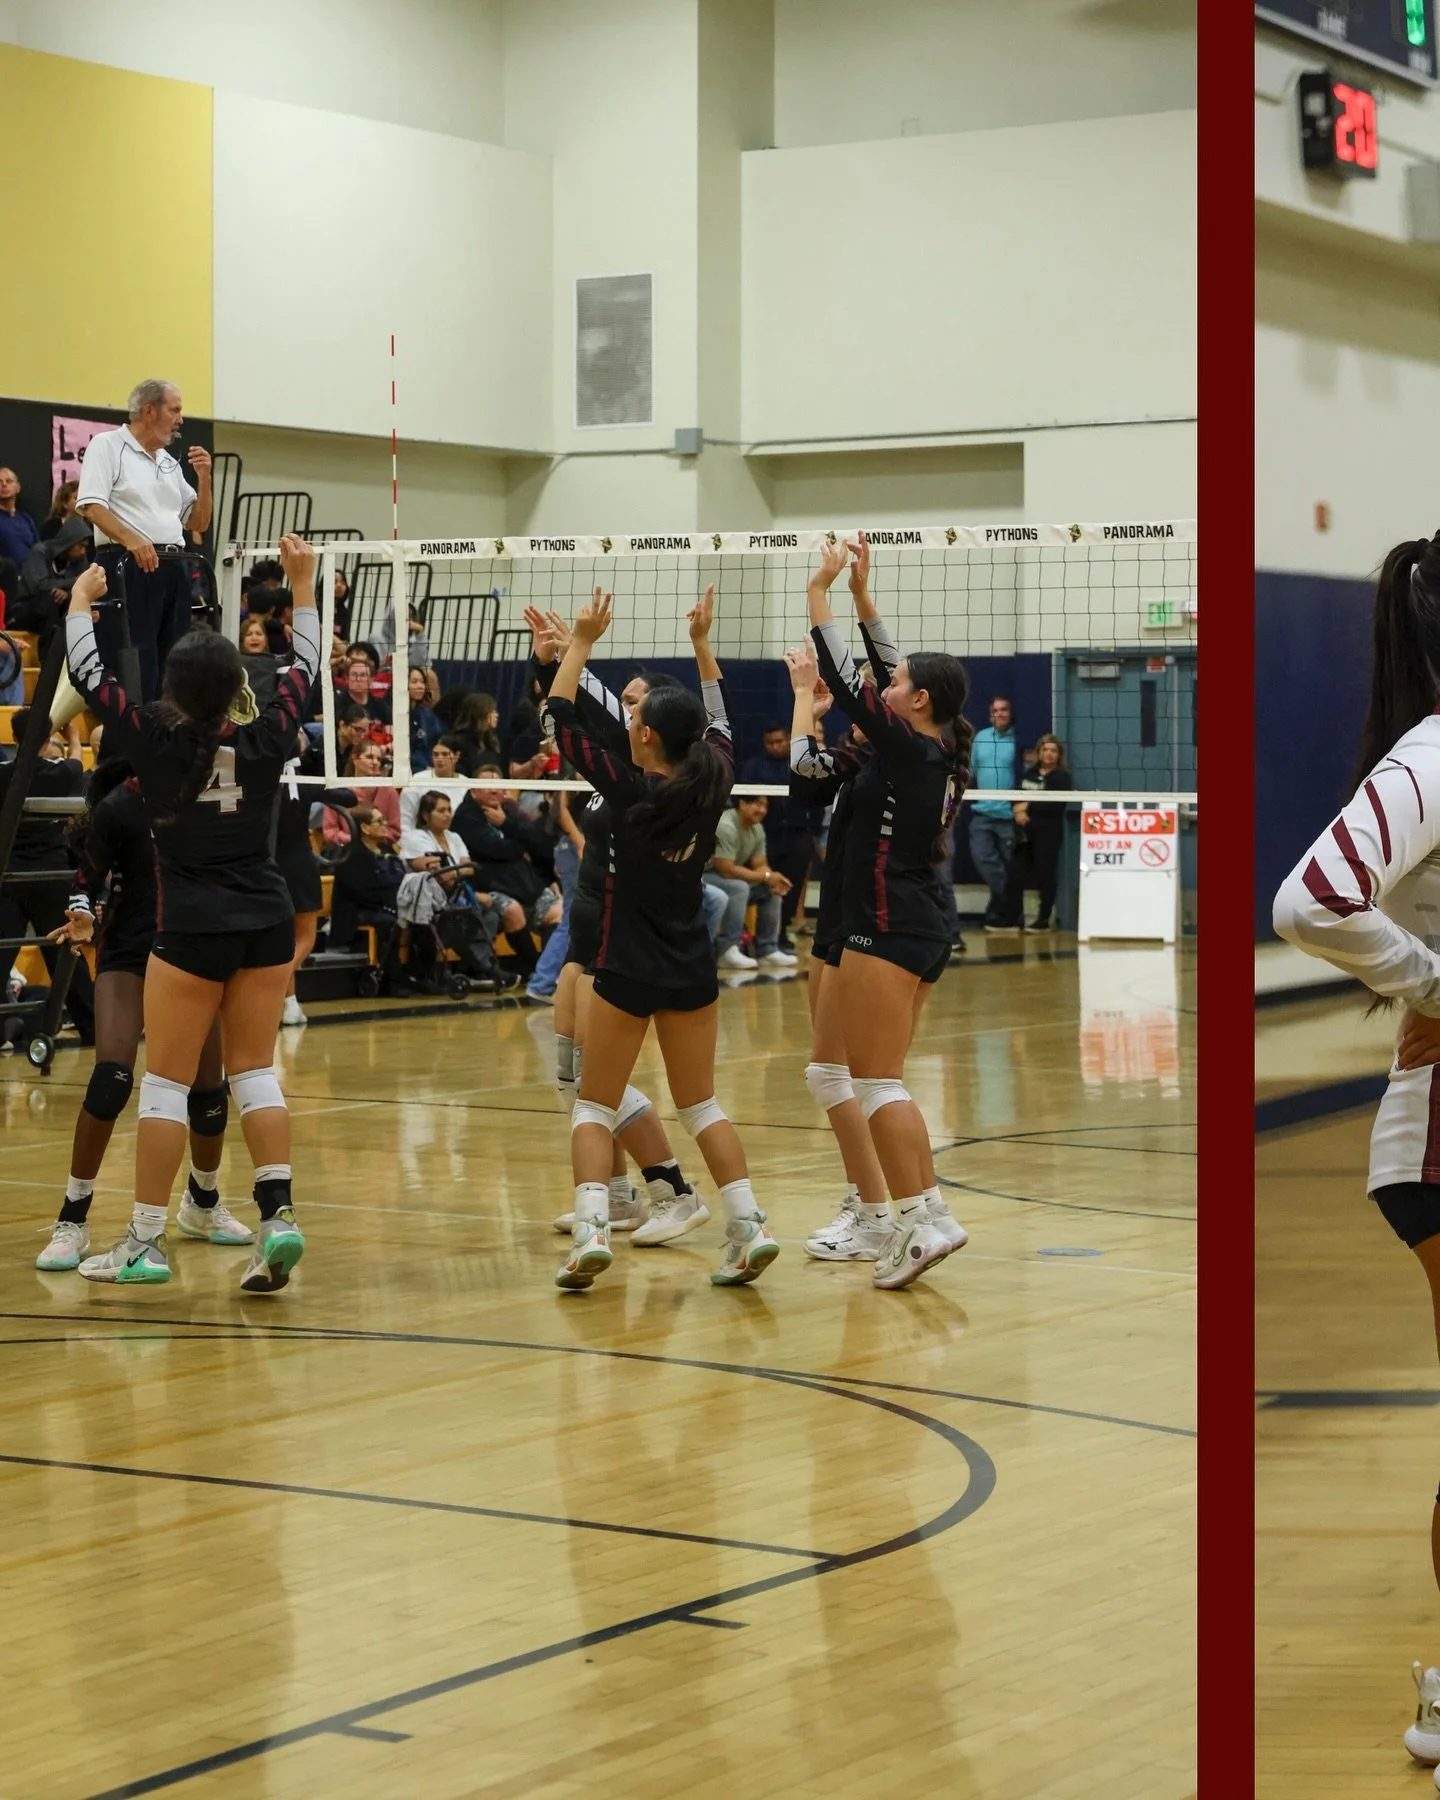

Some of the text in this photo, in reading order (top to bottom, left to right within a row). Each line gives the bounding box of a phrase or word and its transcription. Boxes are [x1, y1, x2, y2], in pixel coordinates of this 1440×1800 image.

[1332, 81, 1378, 169] 20
[420, 524, 1174, 555] PANORAMA PYTHONS PANORAMA PYTHONS ANORAMA PYTHONS PANORAMA
[196, 745, 243, 813] 4
[1103, 813, 1157, 832] STOP
[1087, 840, 1132, 850] NOT AN
[1093, 852, 1126, 865] EXIT
